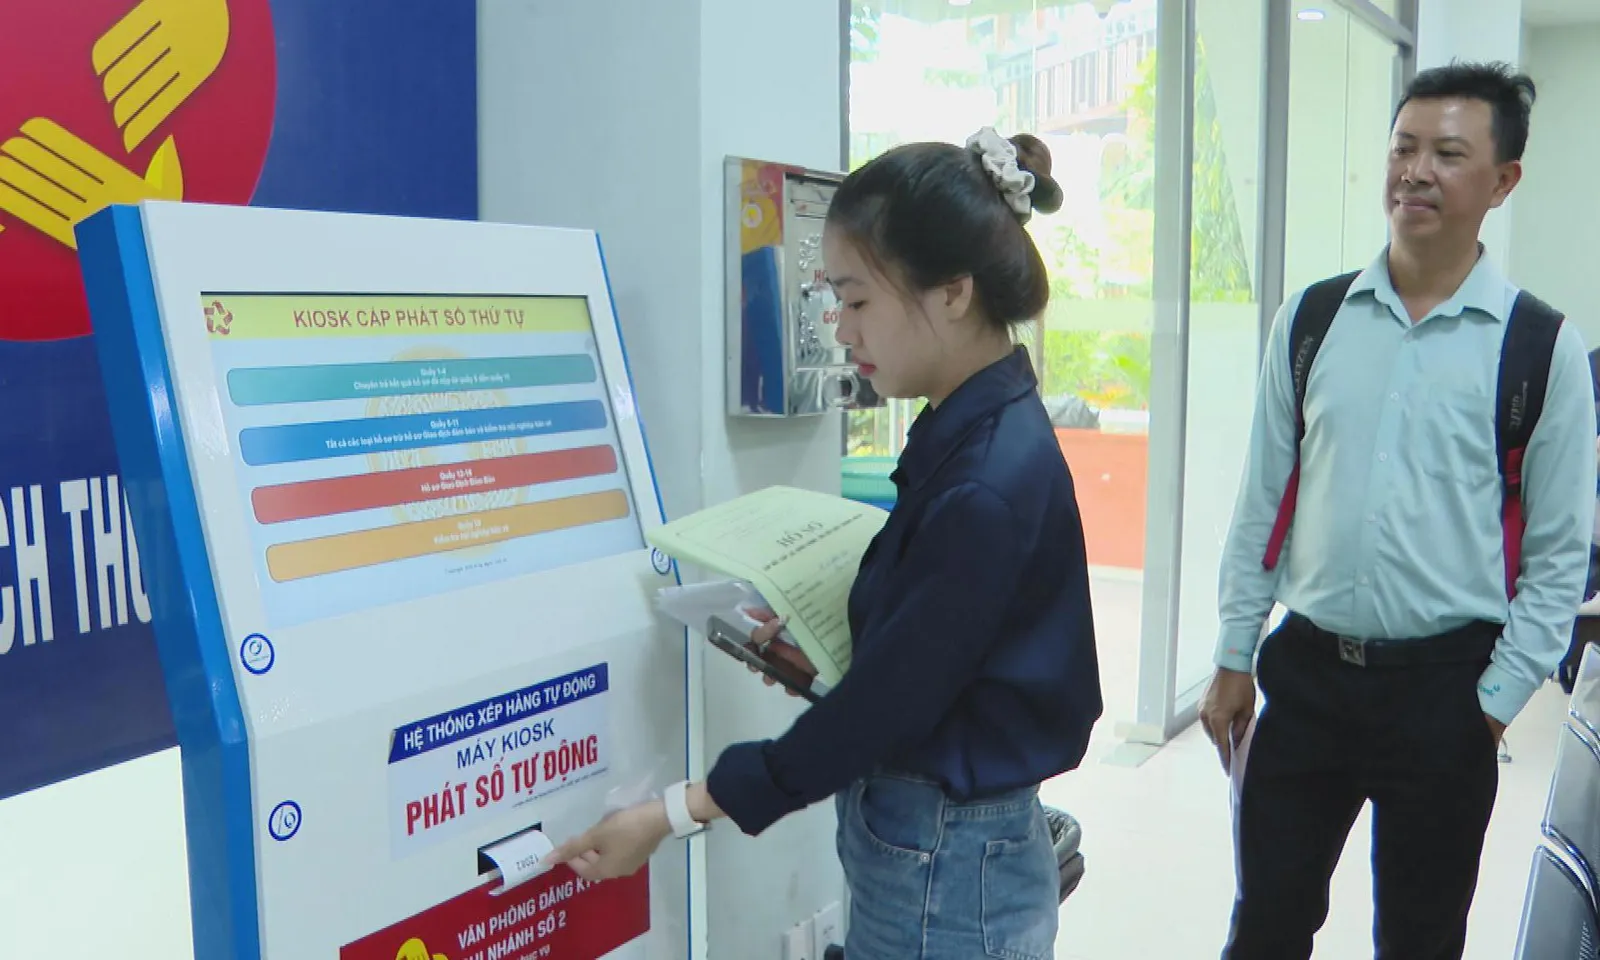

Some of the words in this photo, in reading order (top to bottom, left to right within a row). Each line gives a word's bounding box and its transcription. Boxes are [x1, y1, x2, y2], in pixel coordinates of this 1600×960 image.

[293, 309, 352, 328] KIOSK
[395, 305, 438, 326] PHÁT
[404, 726, 423, 751] HỆ
[426, 713, 476, 743] THỐNG
[477, 701, 503, 726] XẾP
[506, 692, 541, 717] HÀNG
[544, 686, 561, 706] TỰ
[563, 673, 596, 699] ĐỘNG
[457, 738, 496, 769] MÁY
[502, 718, 555, 754] KIOSK
[406, 781, 467, 836] PHÁT
[475, 756, 505, 808] SỐ
[511, 752, 540, 795] TỰ
[543, 734, 598, 782] ĐỘNG
[488, 925, 534, 960] NHÁNH
[537, 910, 556, 938] SỐ
[558, 910, 566, 928] 2
[489, 899, 536, 936] PHÒNG
